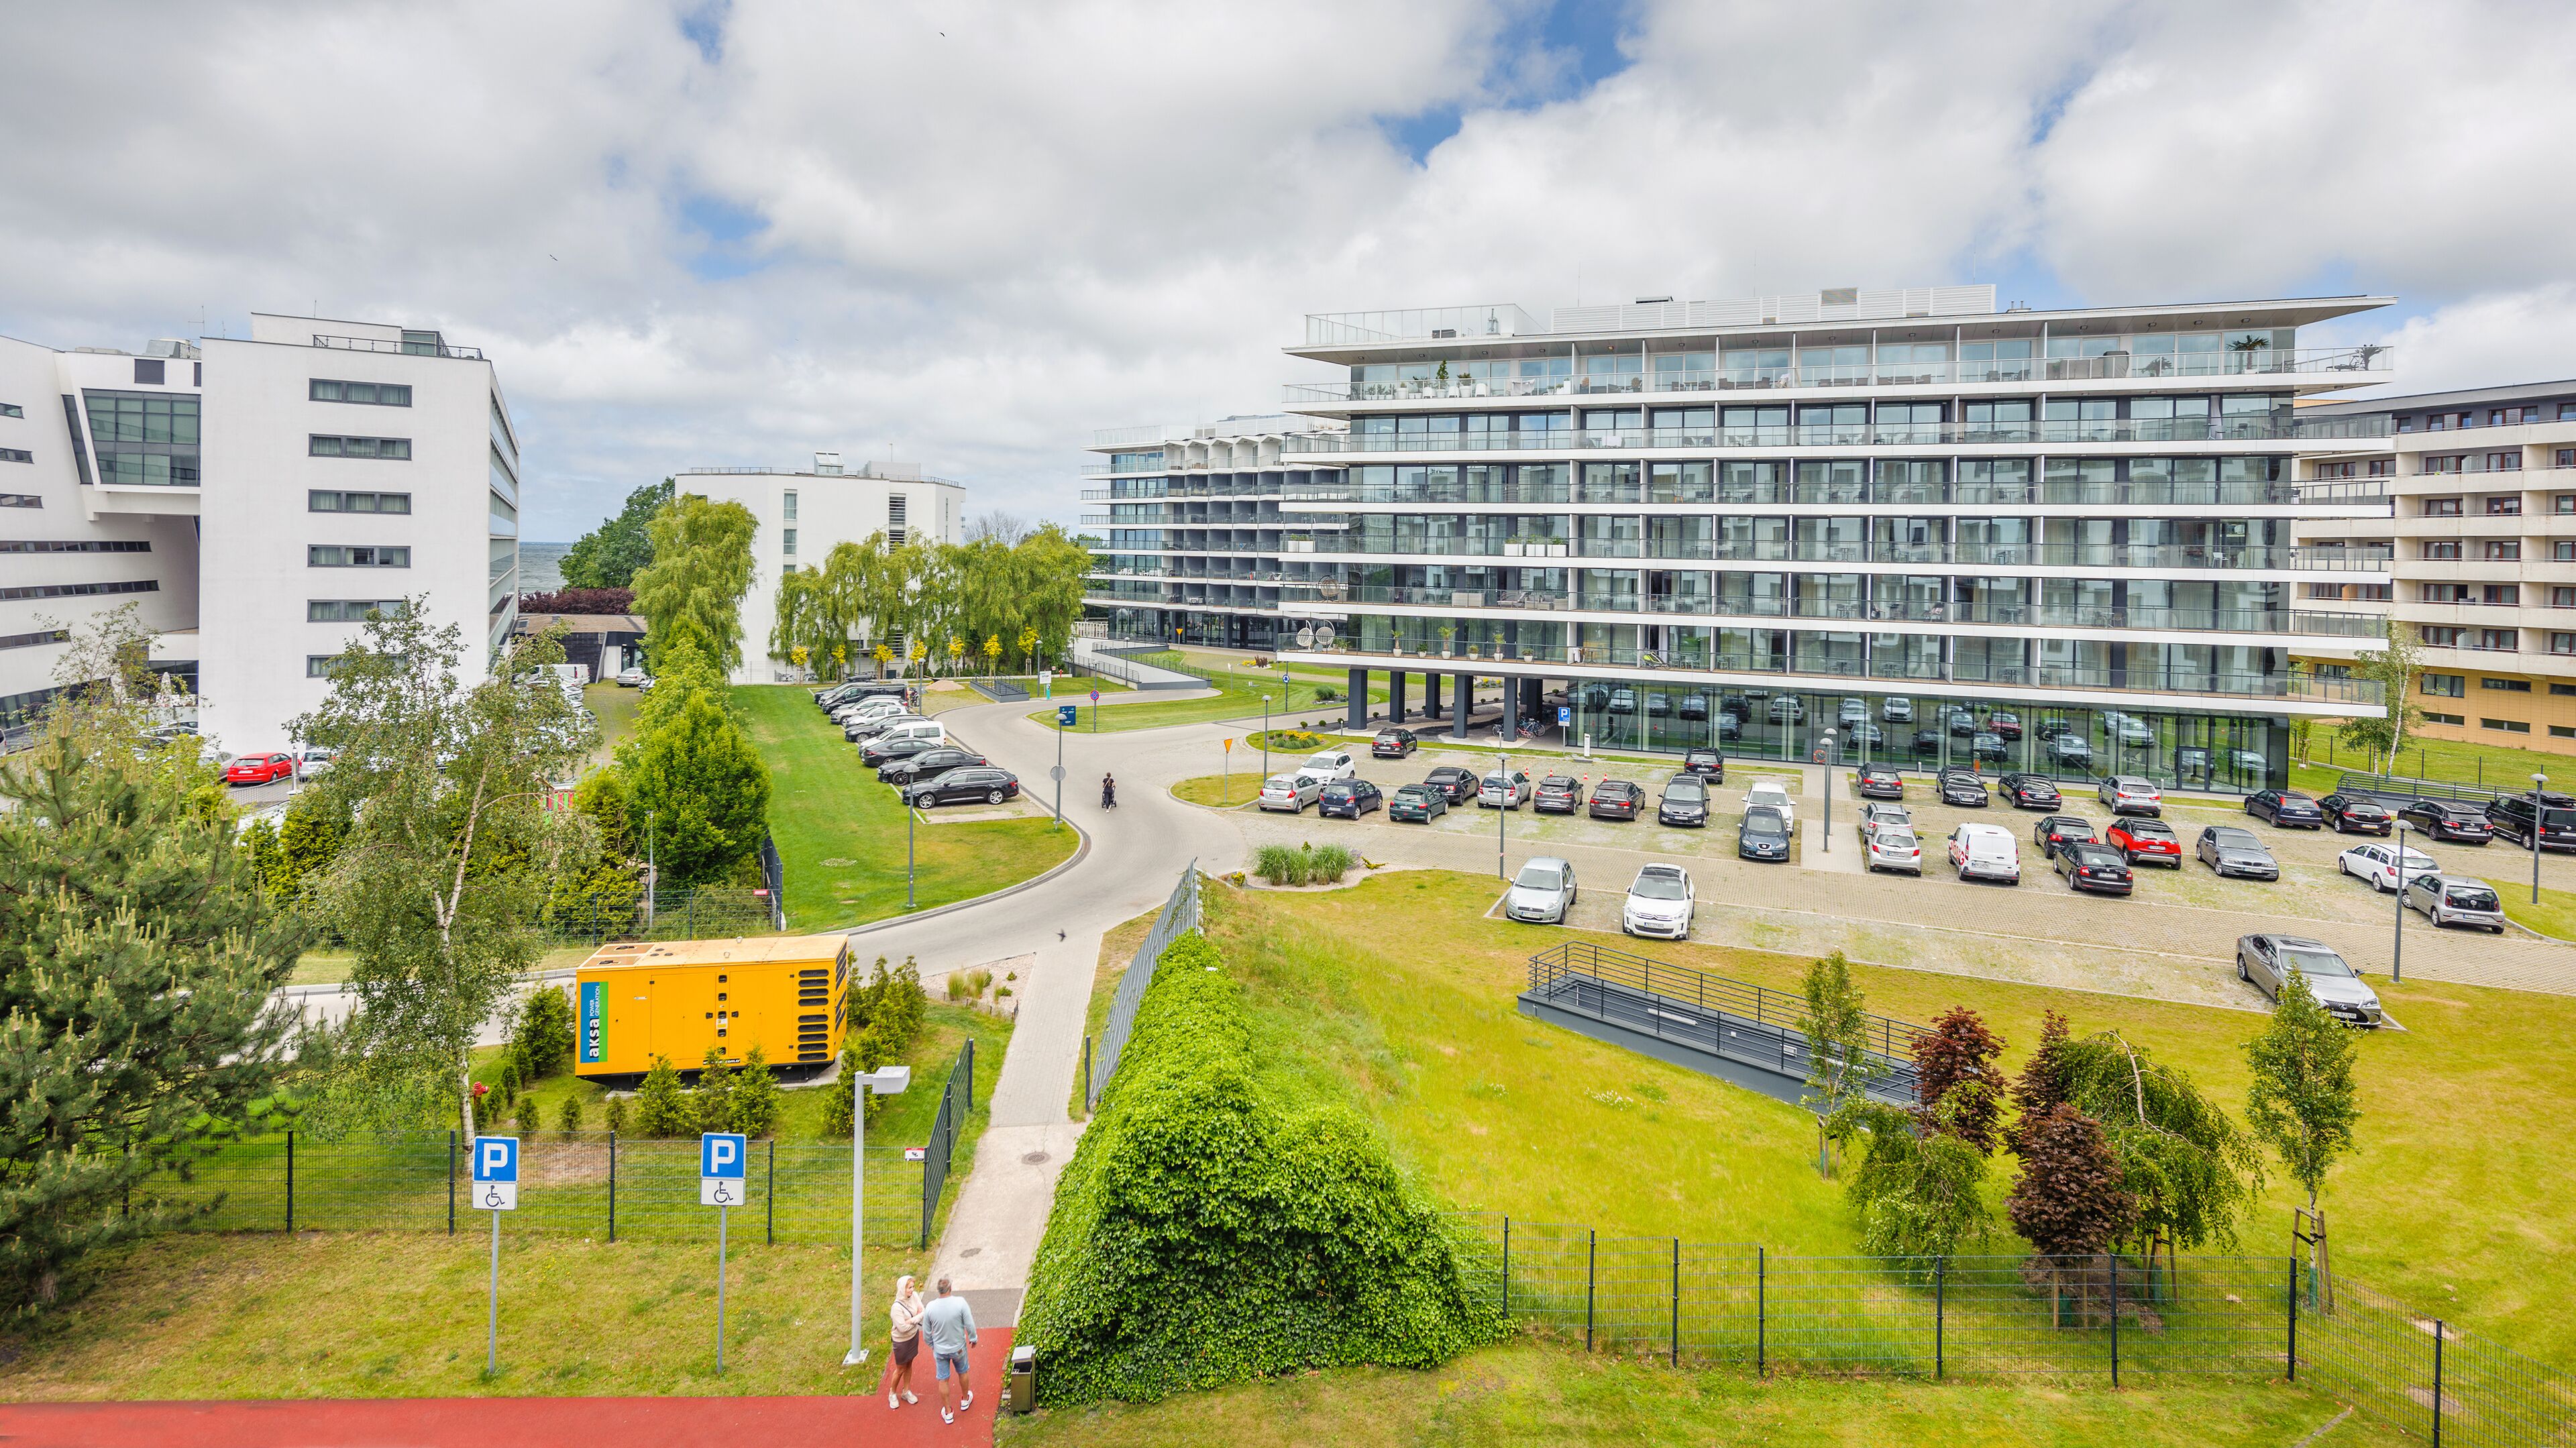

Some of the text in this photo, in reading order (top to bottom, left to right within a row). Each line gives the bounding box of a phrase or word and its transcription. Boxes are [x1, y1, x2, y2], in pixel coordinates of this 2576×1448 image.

[1560, 708, 1568, 718] P
[589, 1018, 600, 1058] aksa
[483, 1143, 508, 1177] P
[711, 1139, 736, 1173] P
